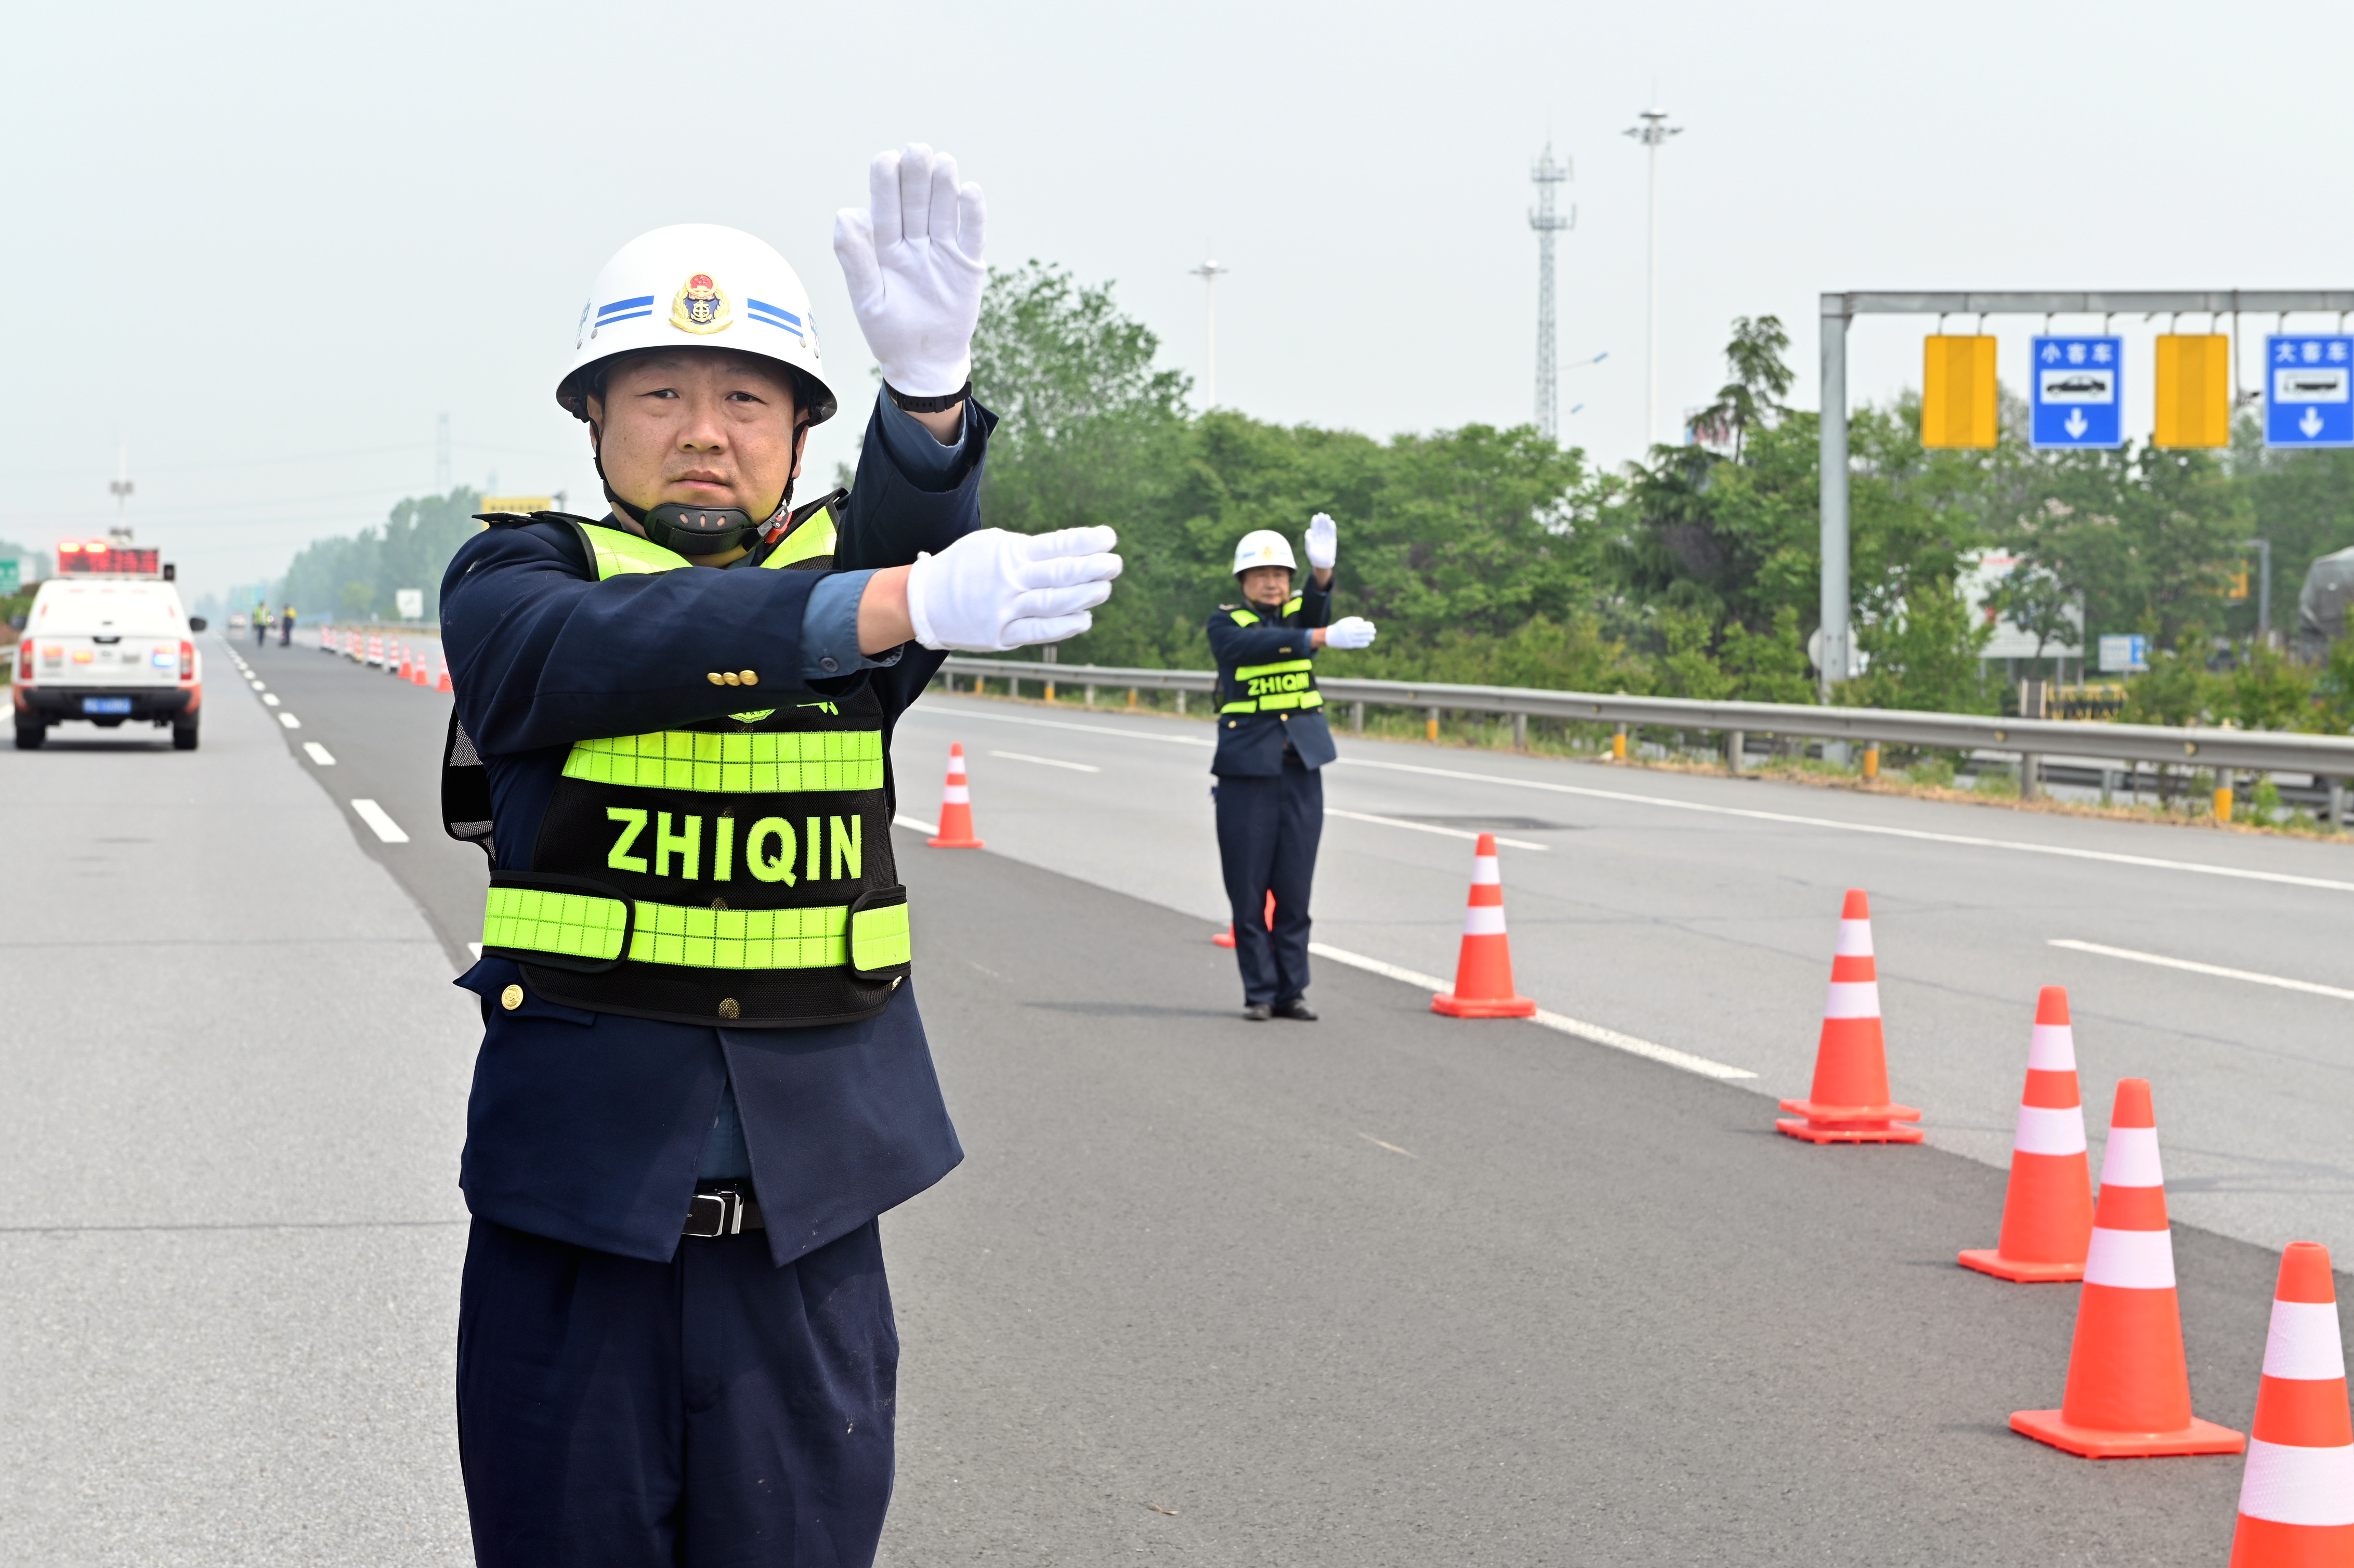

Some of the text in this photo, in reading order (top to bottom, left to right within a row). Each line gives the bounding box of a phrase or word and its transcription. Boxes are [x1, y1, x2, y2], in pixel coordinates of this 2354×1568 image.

[2041, 342, 2113, 364] 小客车
[2274, 341, 2349, 363] 大客车
[1248, 672, 1310, 696] ZHIQIN
[606, 807, 861, 887] ZHIQIN
